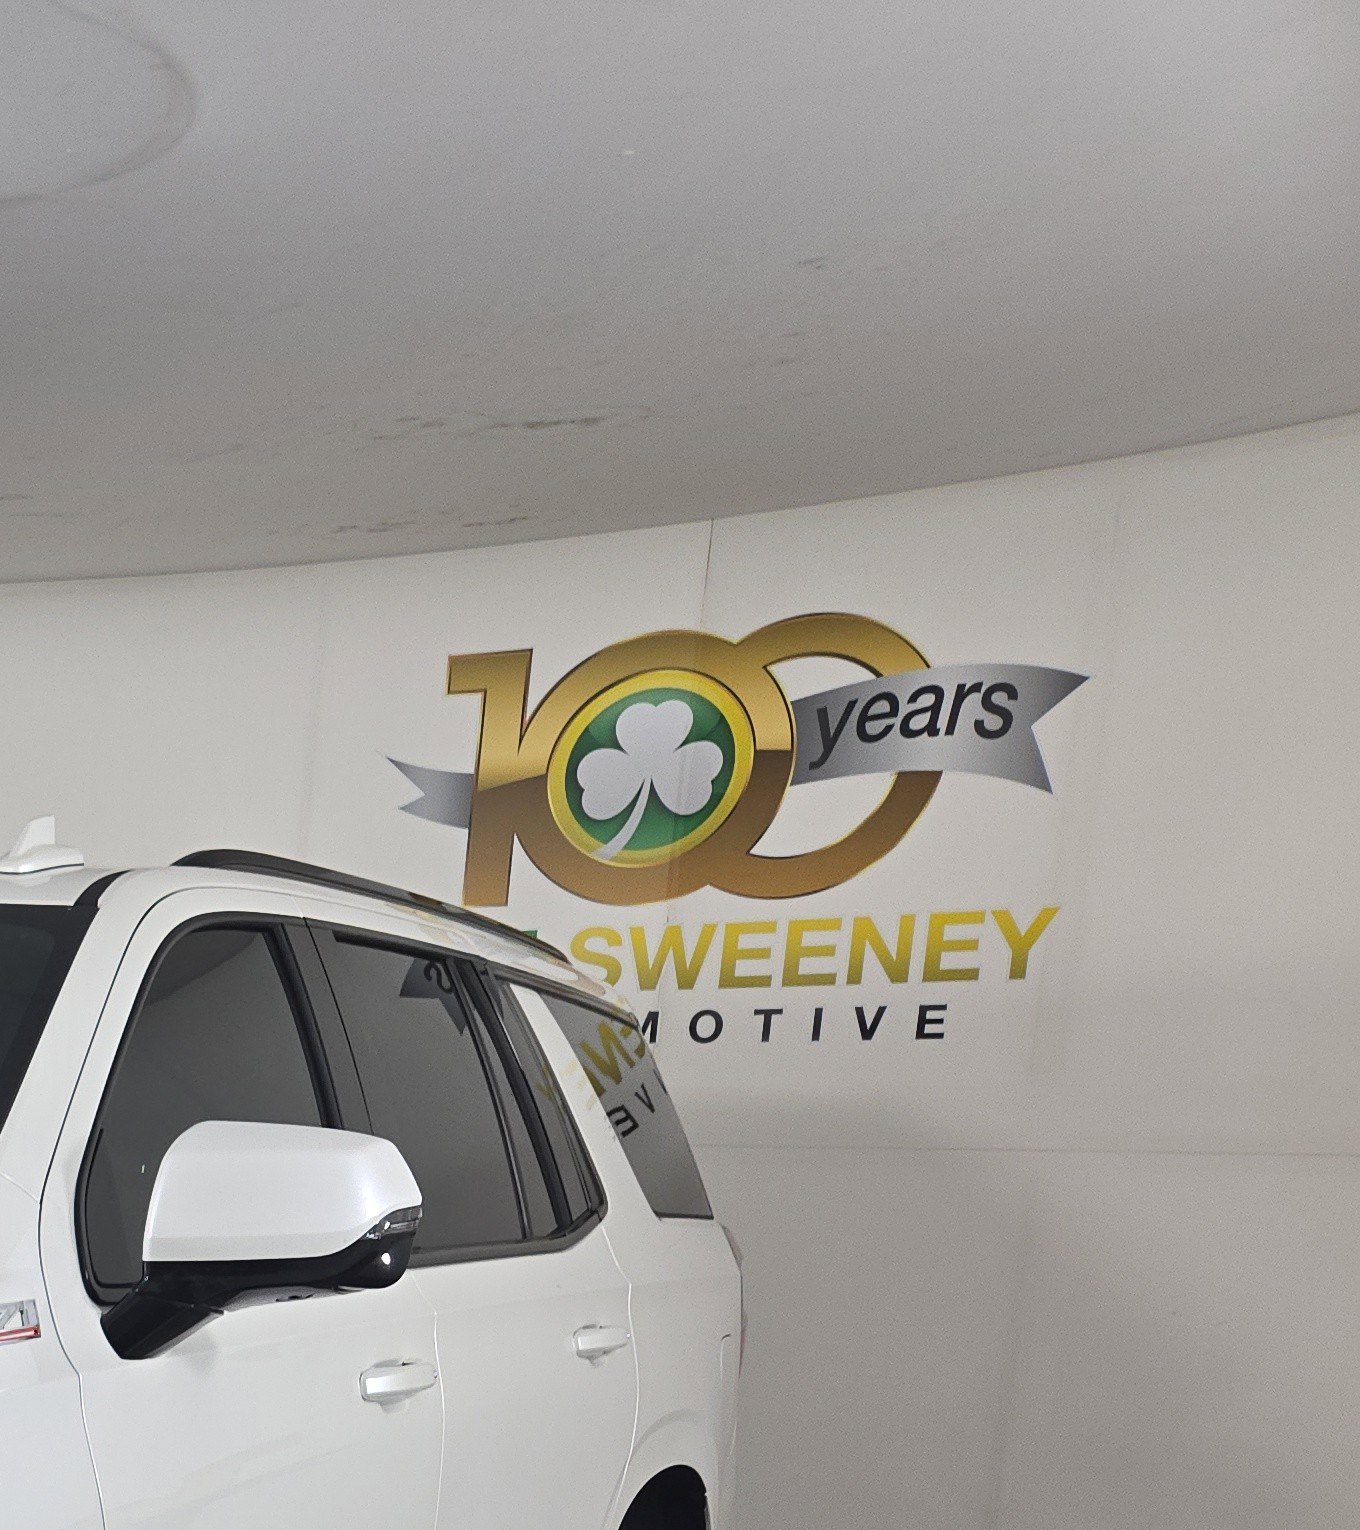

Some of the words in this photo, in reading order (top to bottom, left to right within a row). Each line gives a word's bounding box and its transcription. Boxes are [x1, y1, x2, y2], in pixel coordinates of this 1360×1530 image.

[445, 612, 943, 907] 100
[808, 680, 1020, 772] years
[570, 905, 1062, 992] SWEENEY
